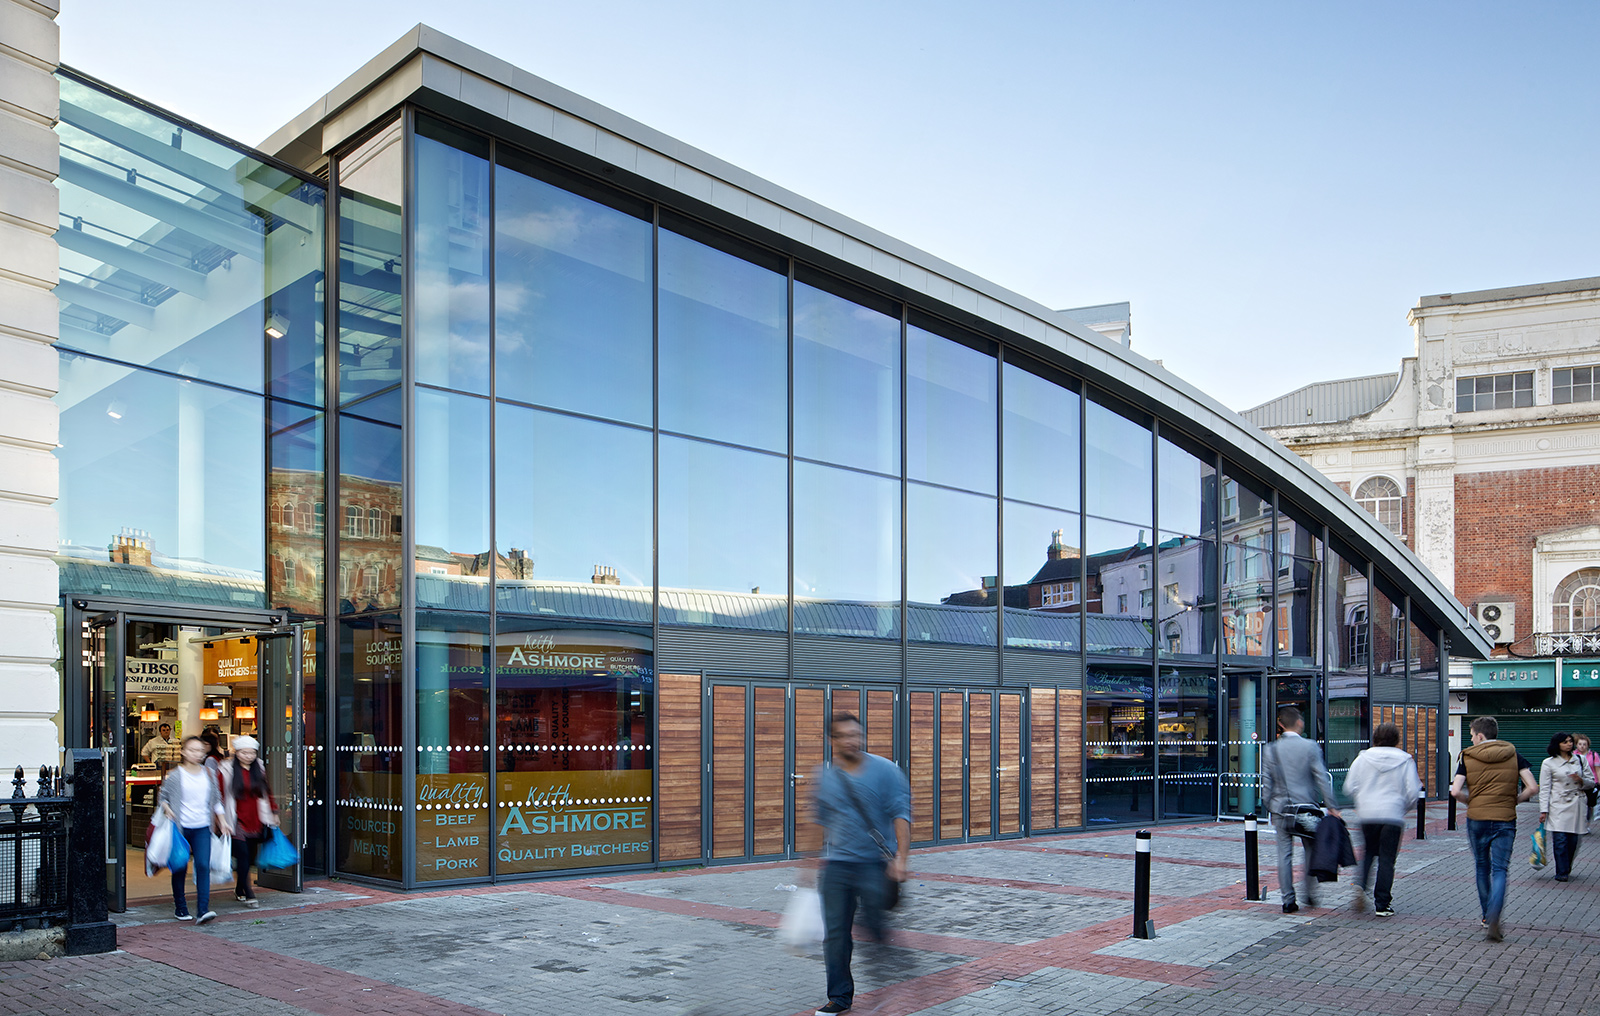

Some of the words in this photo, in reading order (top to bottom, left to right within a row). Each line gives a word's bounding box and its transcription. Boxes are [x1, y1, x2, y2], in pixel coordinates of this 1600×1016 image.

[524, 634, 556, 653] Keith
[218, 657, 243, 669] QUALITY
[366, 654, 402, 665] SOURCE
[507, 646, 605, 668] ASHMORE
[218, 666, 250, 678] BUTCHERS
[419, 782, 484, 804] Quality
[526, 783, 573, 813] Keith
[347, 816, 396, 834] SOURCED
[435, 813, 477, 826] BEEF
[498, 806, 646, 836] ASHMORE
[353, 840, 389, 857] MEATS
[435, 836, 480, 848] LAMB
[498, 846, 567, 863] QUALITY
[571, 841, 650, 857] BUTCHERS
[435, 858, 479, 871] PORK
